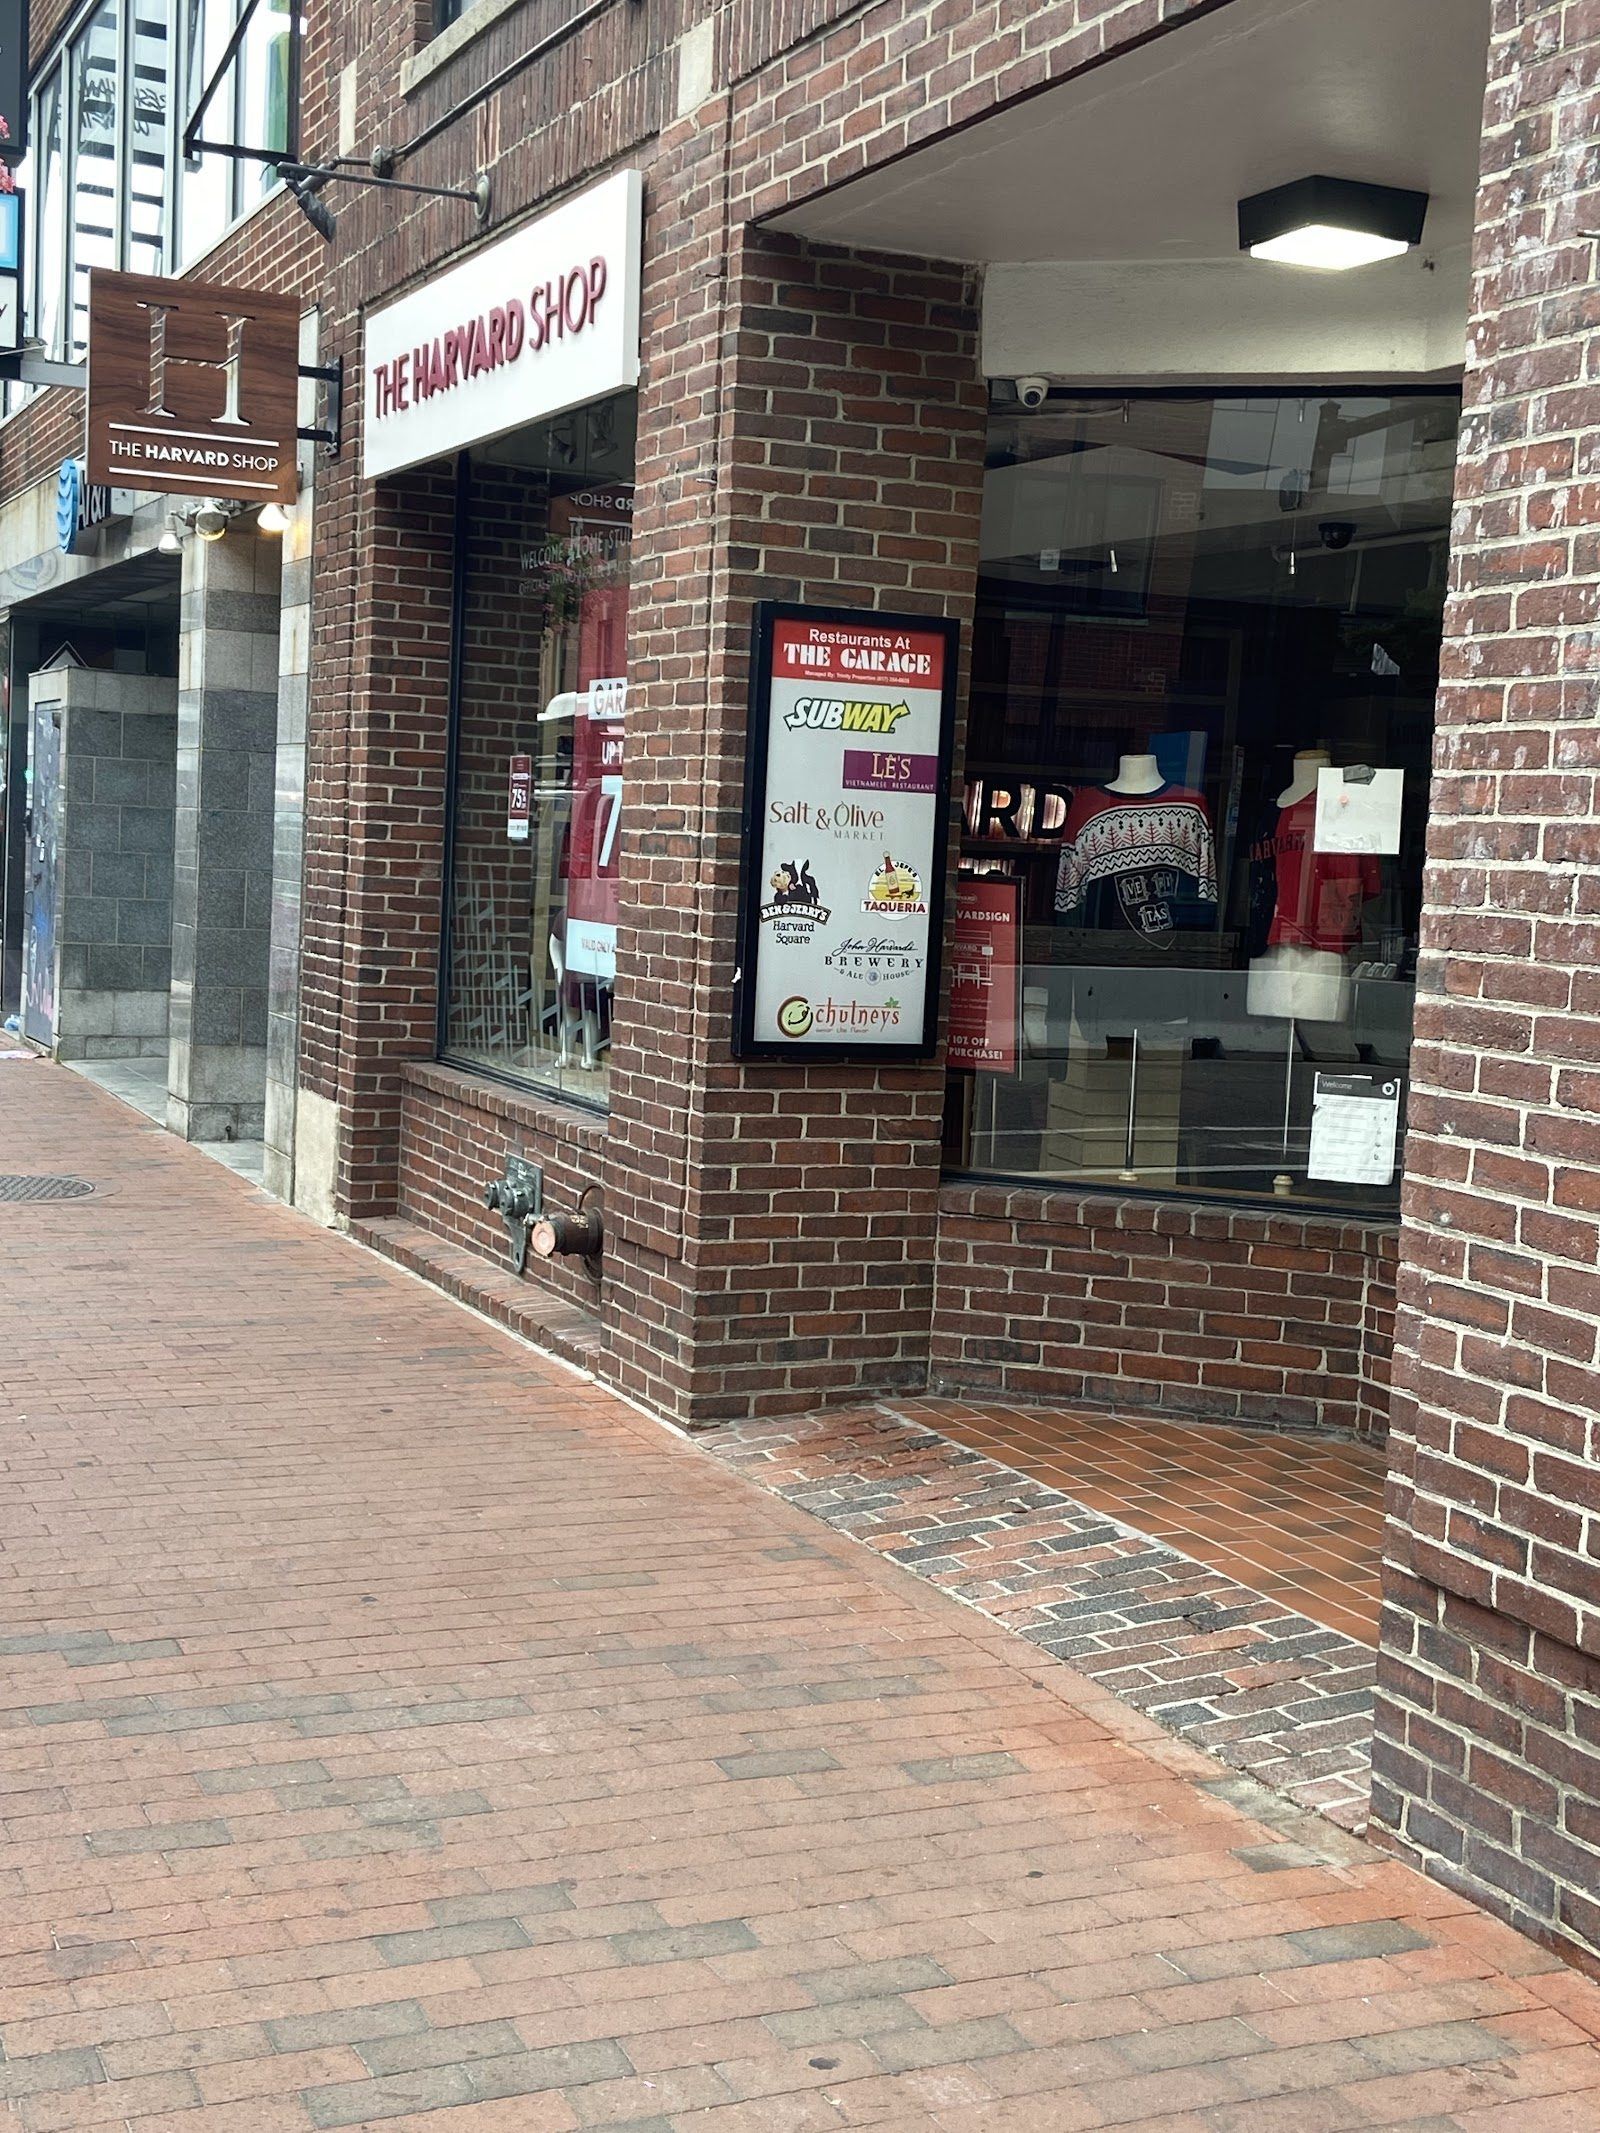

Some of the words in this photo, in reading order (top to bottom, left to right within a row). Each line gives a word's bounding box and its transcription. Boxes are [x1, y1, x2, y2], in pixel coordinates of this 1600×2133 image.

[373, 353, 410, 419] THE
[413, 299, 525, 404] HARVARD
[529, 255, 607, 351] SHOP
[136, 301, 256, 426] H
[109, 440, 142, 458] THE
[145, 444, 229, 466] HARVARD
[232, 453, 278, 471] SHOP
[520, 543, 564, 570] WELCOME
[809, 629, 892, 648] Restaurants
[894, 635, 910, 650] At
[783, 643, 831, 667] THE
[840, 649, 931, 675] GARAGE
[784, 697, 911, 734] SUBWAY
[602, 741, 614, 764] UP
[845, 779, 887, 788] VIETNAMESE
[892, 781, 934, 790] RESTAURANT
[769, 801, 811, 825] Salt
[815, 808, 831, 830] &
[834, 801, 884, 829] Olive
[834, 829, 885, 841] MARKET
[875, 868, 884, 877] EL
[1127, 881, 1142, 895] VE
[863, 901, 926, 913] TAQUERIA
[956, 910, 1010, 922] VARDSIGN
[1146, 908, 1168, 922] TAS
[773, 920, 815, 932] Harvard
[775, 933, 811, 945] Square
[832, 938, 866, 957] John
[824, 956, 924, 968] BREWERY
[883, 969, 910, 981] HOUSE
[971, 1037, 990, 1047] OFF
[1321, 1080, 1353, 1091] Welcome
